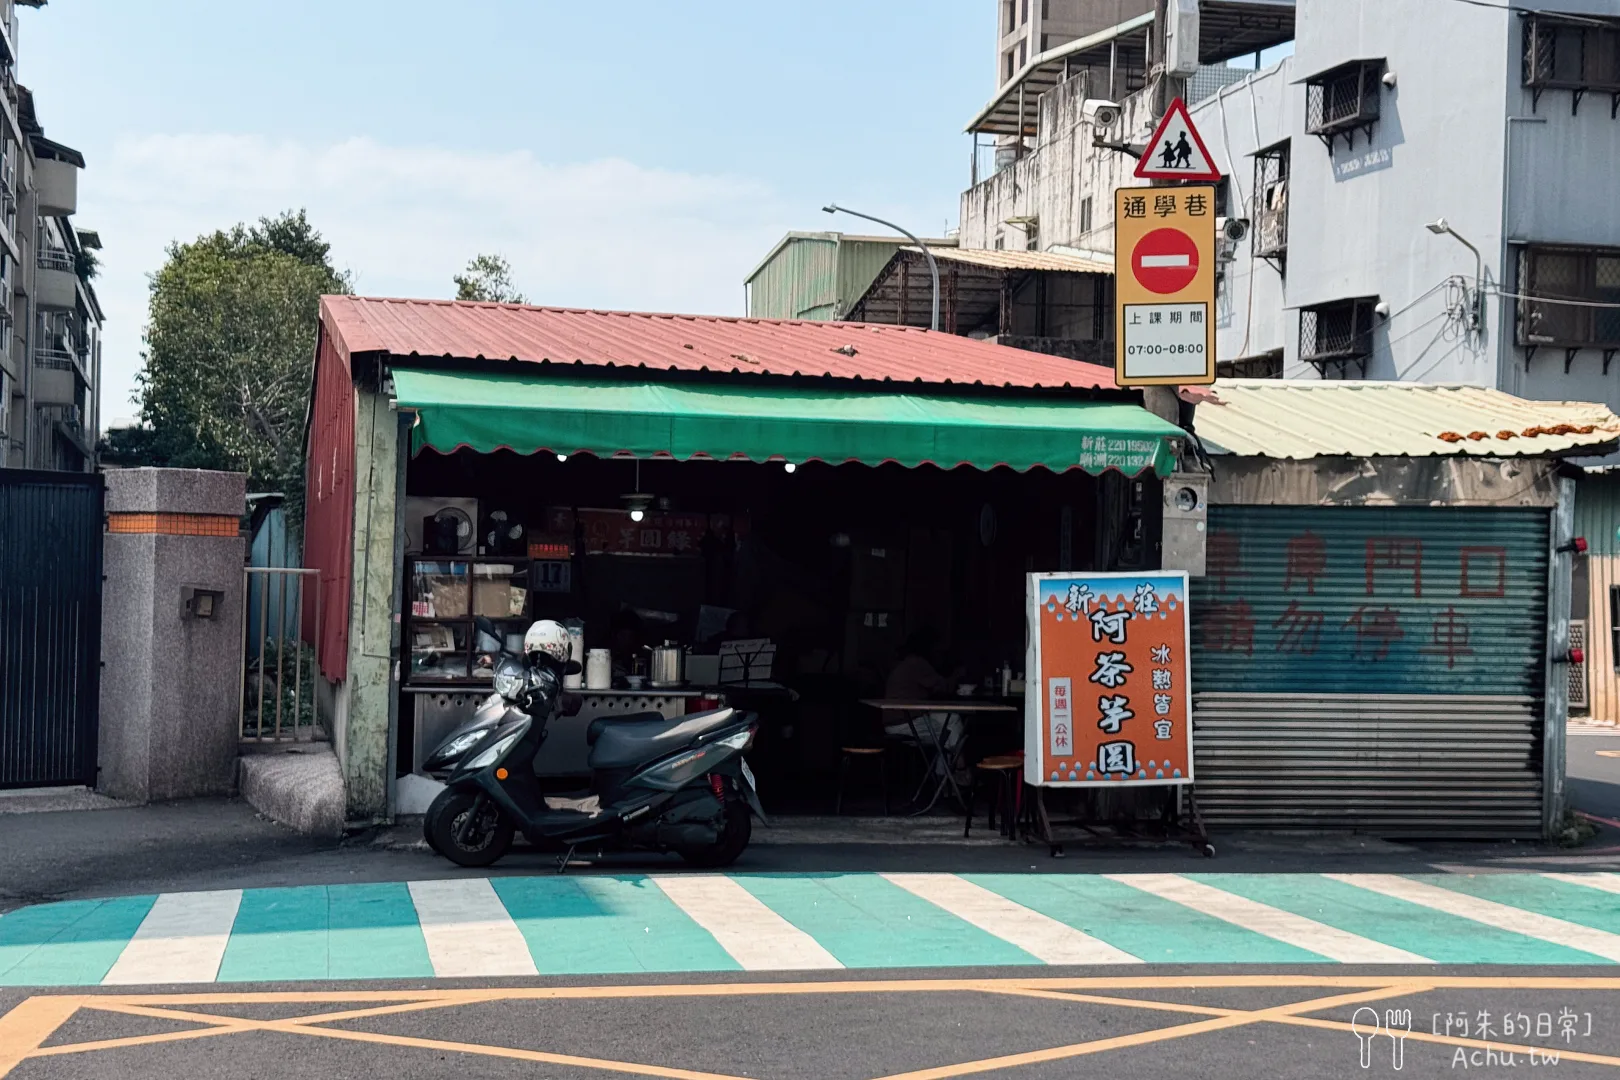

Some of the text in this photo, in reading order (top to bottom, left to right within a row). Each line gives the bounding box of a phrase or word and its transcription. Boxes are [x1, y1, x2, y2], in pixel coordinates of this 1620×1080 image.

[1123, 194, 1208, 219] 通學巷
[1128, 311, 1203, 325] 上課期間
[1128, 343, 1203, 355] 07:00-08:00
[1063, 582, 1159, 614] 新莊
[1201, 595, 1474, 669] 請勿停車
[1088, 609, 1136, 776] 阿茶芋圓
[1150, 643, 1173, 740] 冰熱皆宜
[1054, 685, 1069, 748] 每週一公休
